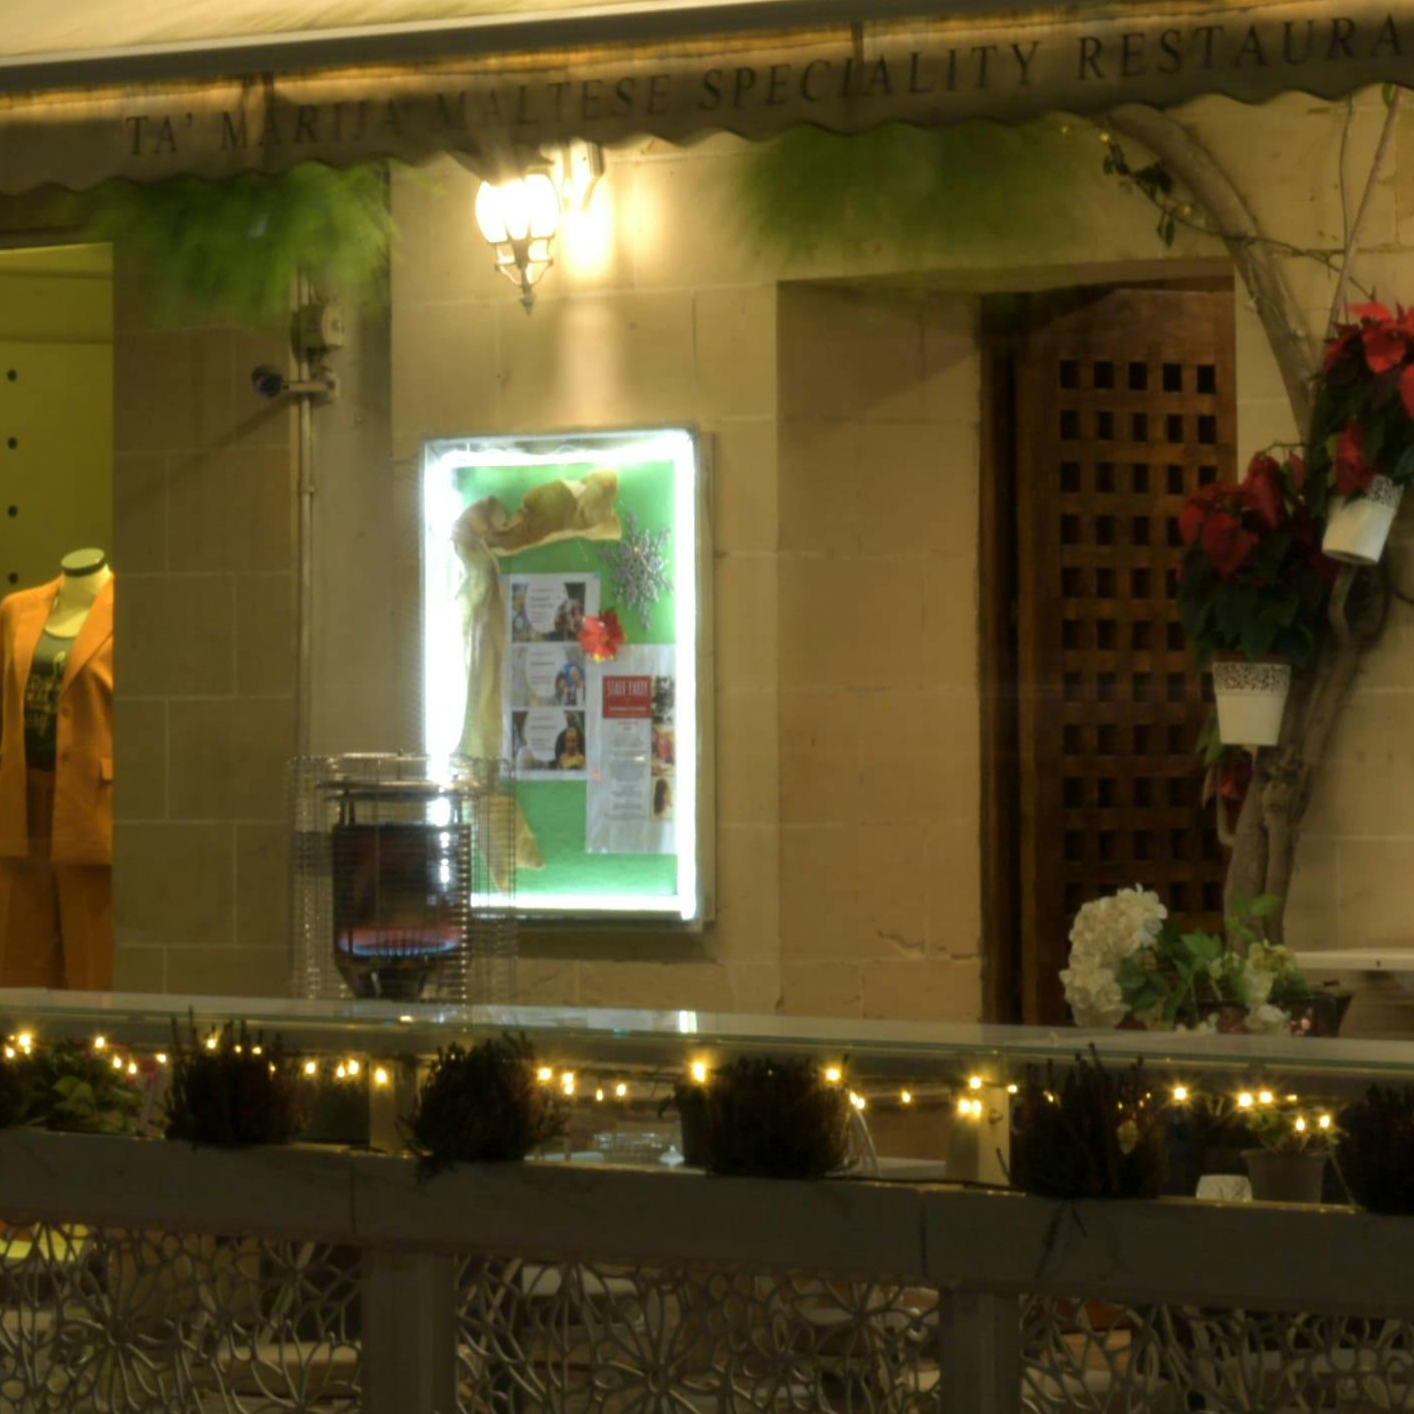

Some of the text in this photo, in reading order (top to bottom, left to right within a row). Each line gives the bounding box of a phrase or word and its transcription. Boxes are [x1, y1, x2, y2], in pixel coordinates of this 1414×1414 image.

[220, 97, 405, 151] MARIJA
[436, 73, 673, 131] MALTESE
[698, 40, 1041, 113] SPECIALITY
